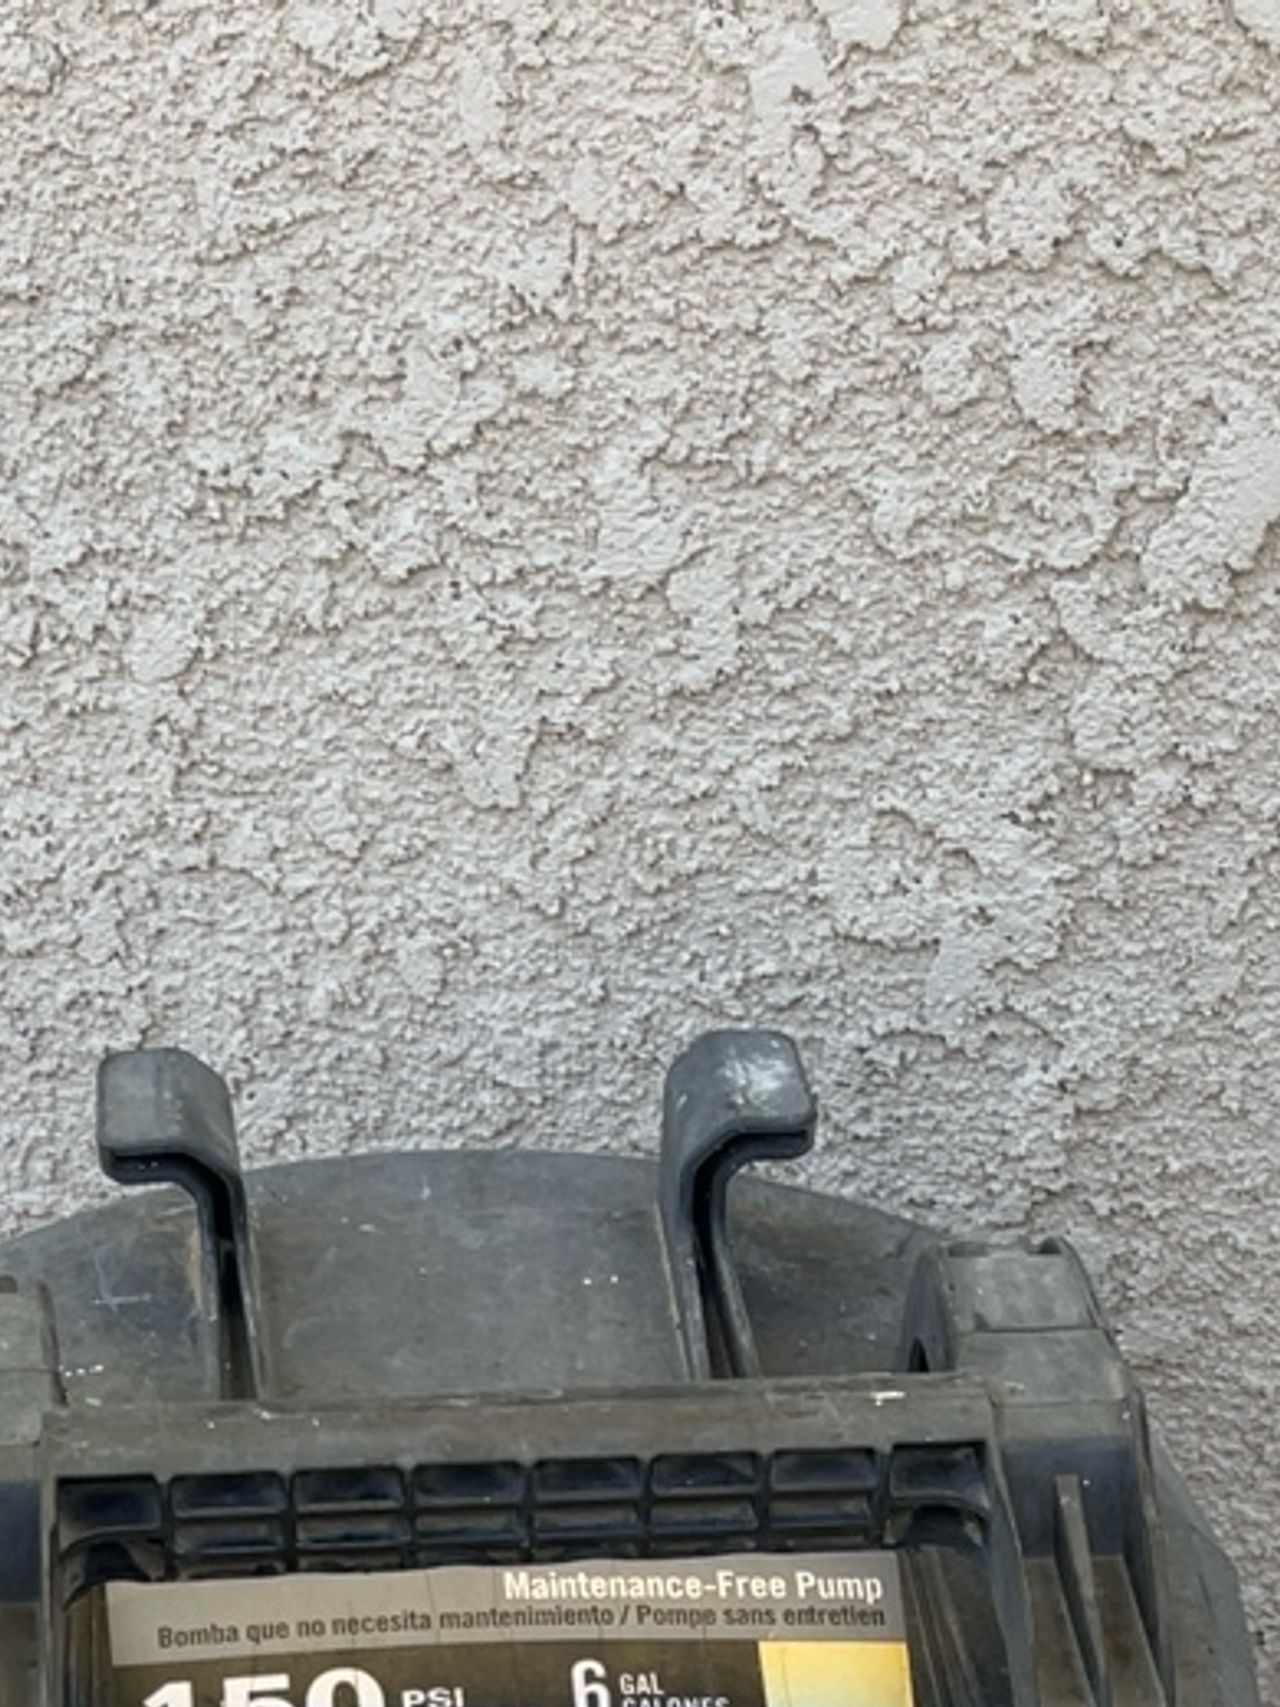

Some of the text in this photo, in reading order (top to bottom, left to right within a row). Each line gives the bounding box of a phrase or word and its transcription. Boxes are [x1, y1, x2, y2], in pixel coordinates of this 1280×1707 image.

[503, 1571, 882, 1603] Maintenance-Free Pump
[157, 1624, 238, 1648] Bomba
[246, 1618, 290, 1645] que
[297, 1620, 326, 1638] no
[332, 1609, 431, 1636] necesita
[439, 1605, 615, 1630] mantenimiento
[636, 1606, 717, 1630] Pompe
[722, 1608, 776, 1627] sans
[784, 1605, 886, 1627] entretien
[619, 1672, 665, 1696] GAL
